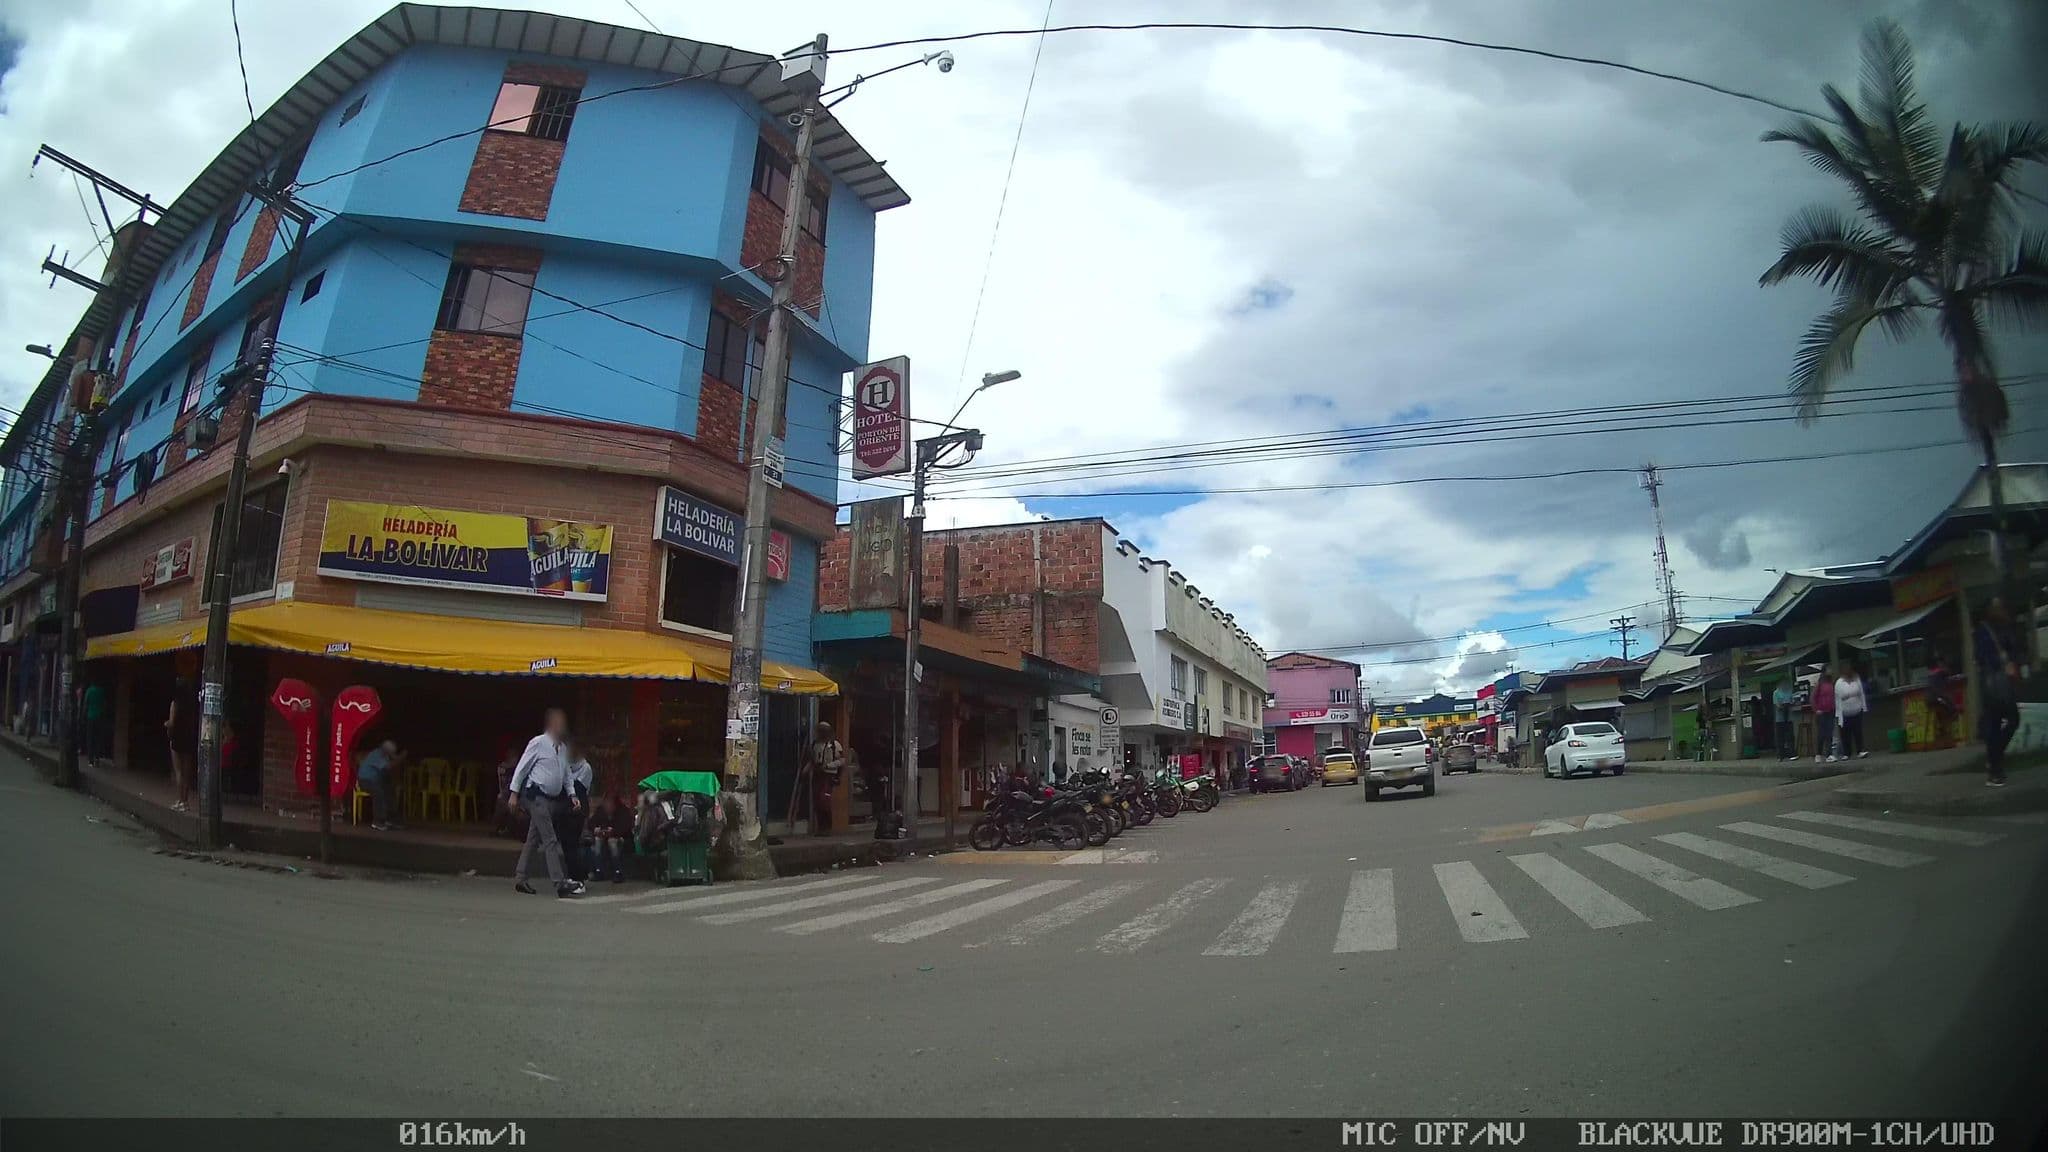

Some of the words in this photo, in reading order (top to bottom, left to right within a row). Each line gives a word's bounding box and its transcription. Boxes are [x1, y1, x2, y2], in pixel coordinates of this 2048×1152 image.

[867, 380, 890, 406] H
[857, 411, 899, 428] HOTEL
[859, 432, 900, 446] ORIENTE
[889, 425, 900, 435] DE
[668, 496, 735, 536] HELADERÍA
[382, 517, 458, 538] HELADERÍA
[666, 516, 682, 536] LA
[685, 523, 735, 554] BOLIVAR
[346, 534, 375, 562] LA
[382, 537, 488, 573] BOLÍVAR
[531, 658, 556, 671] AGUILA
[339, 700, 371, 713] une
